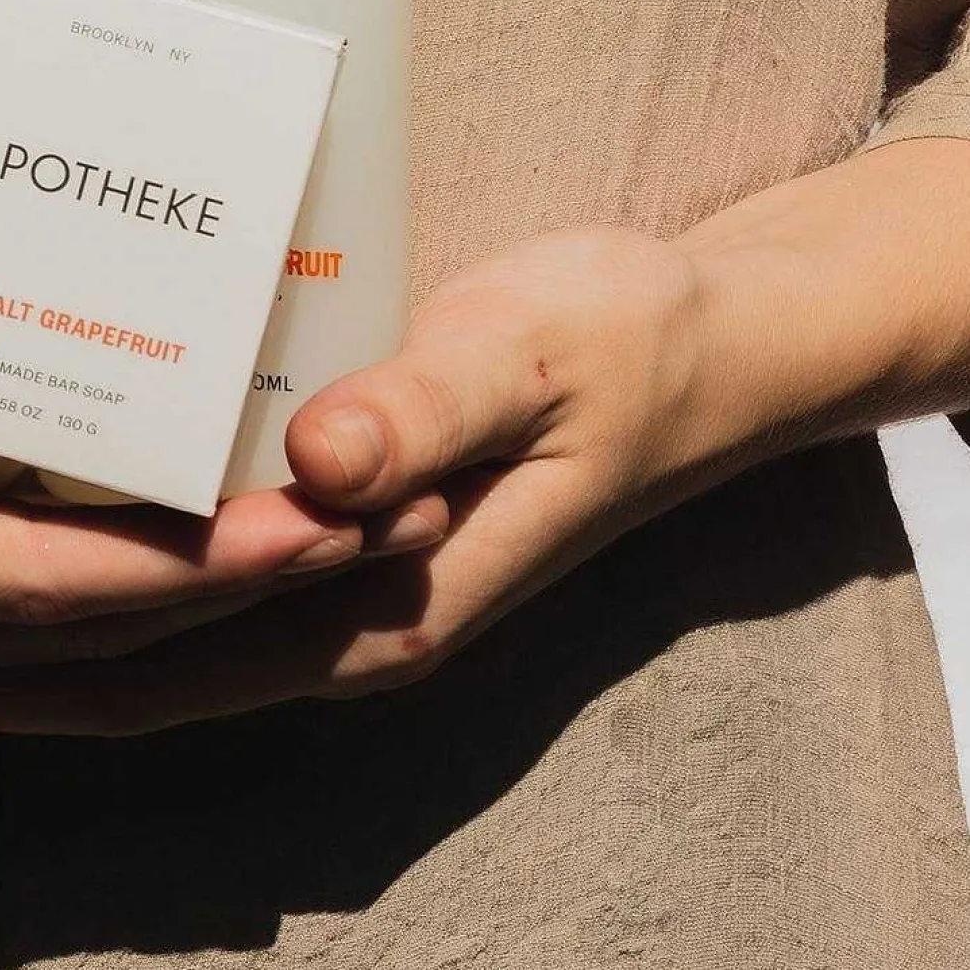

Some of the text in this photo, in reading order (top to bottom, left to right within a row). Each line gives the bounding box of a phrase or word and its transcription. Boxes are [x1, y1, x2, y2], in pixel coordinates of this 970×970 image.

[71, 21, 191, 63] BROOKLYN NY
[40, 309, 186, 364] GRAPEFRUIT
[47, 374, 79, 393] BAR
[83, 385, 125, 405] SOAP
[21, 404, 43, 420] OZ
[58, 414, 83, 431] 130
[86, 422, 98, 435] G
